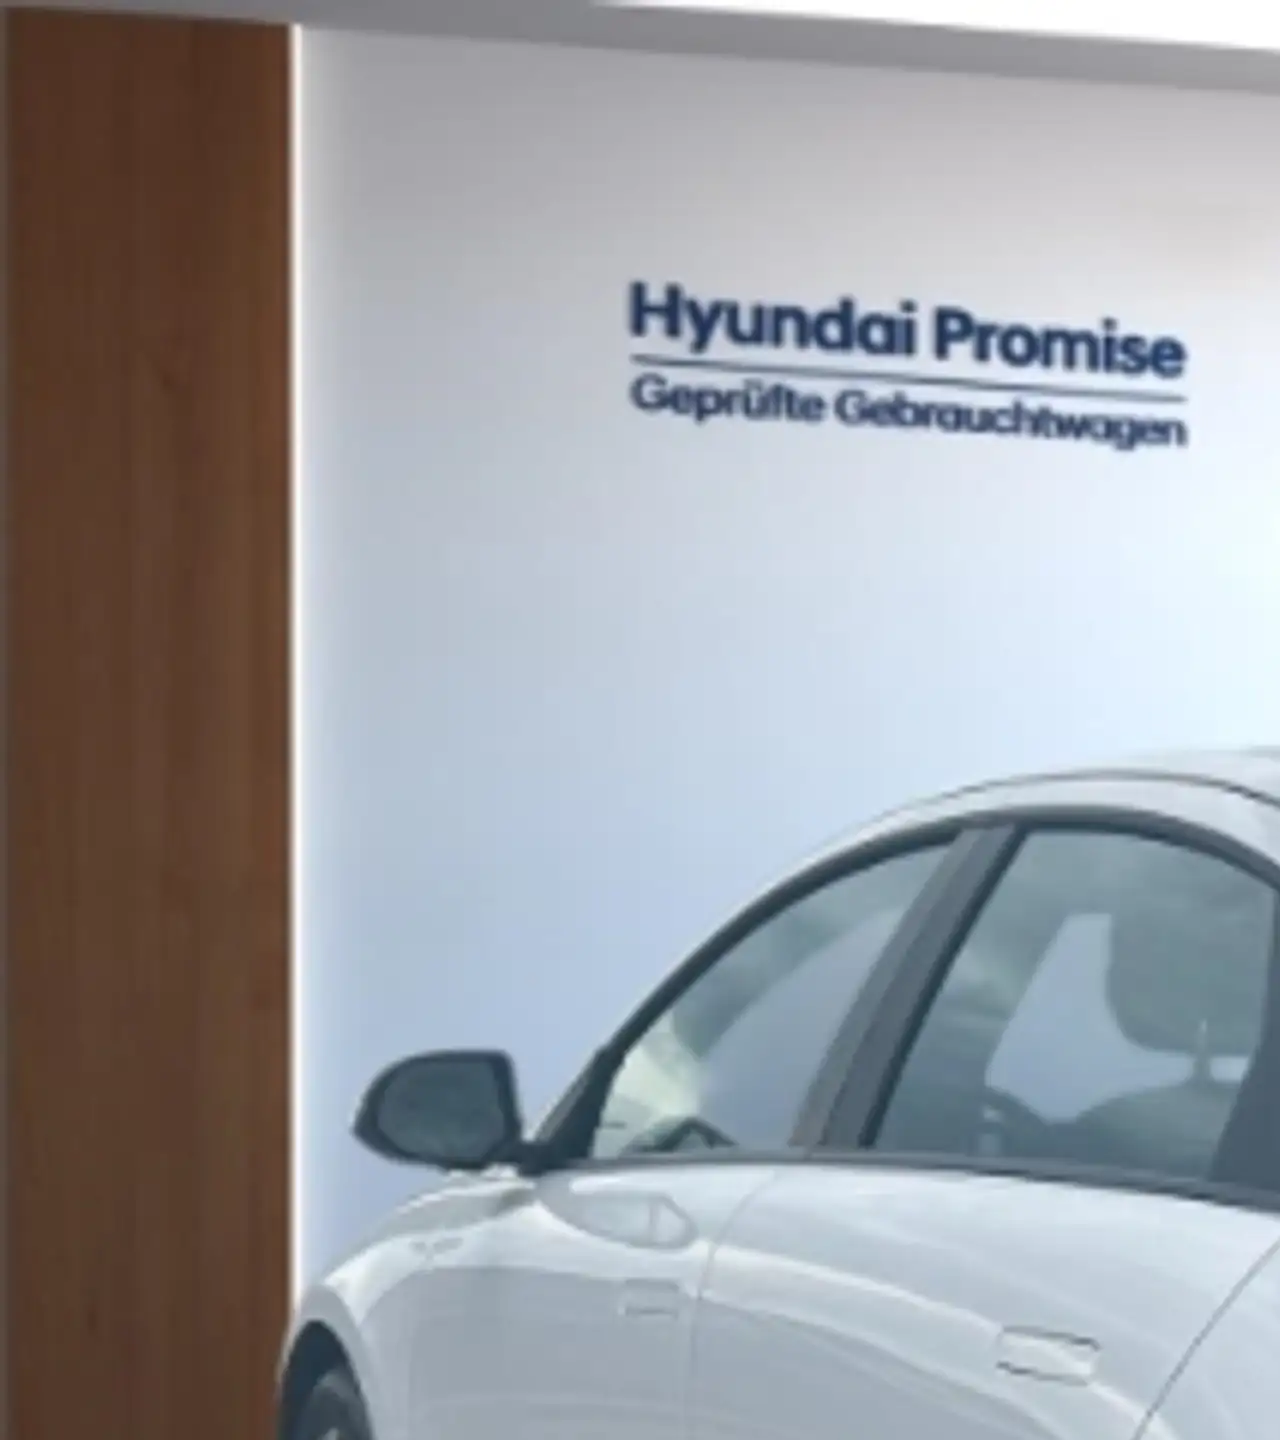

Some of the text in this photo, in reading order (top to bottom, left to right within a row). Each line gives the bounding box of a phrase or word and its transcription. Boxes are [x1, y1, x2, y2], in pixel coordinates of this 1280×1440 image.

[629, 280, 1187, 378] Hyundai Promise
[630, 372, 1187, 450] Geprüfte Gebrauchtwagen
